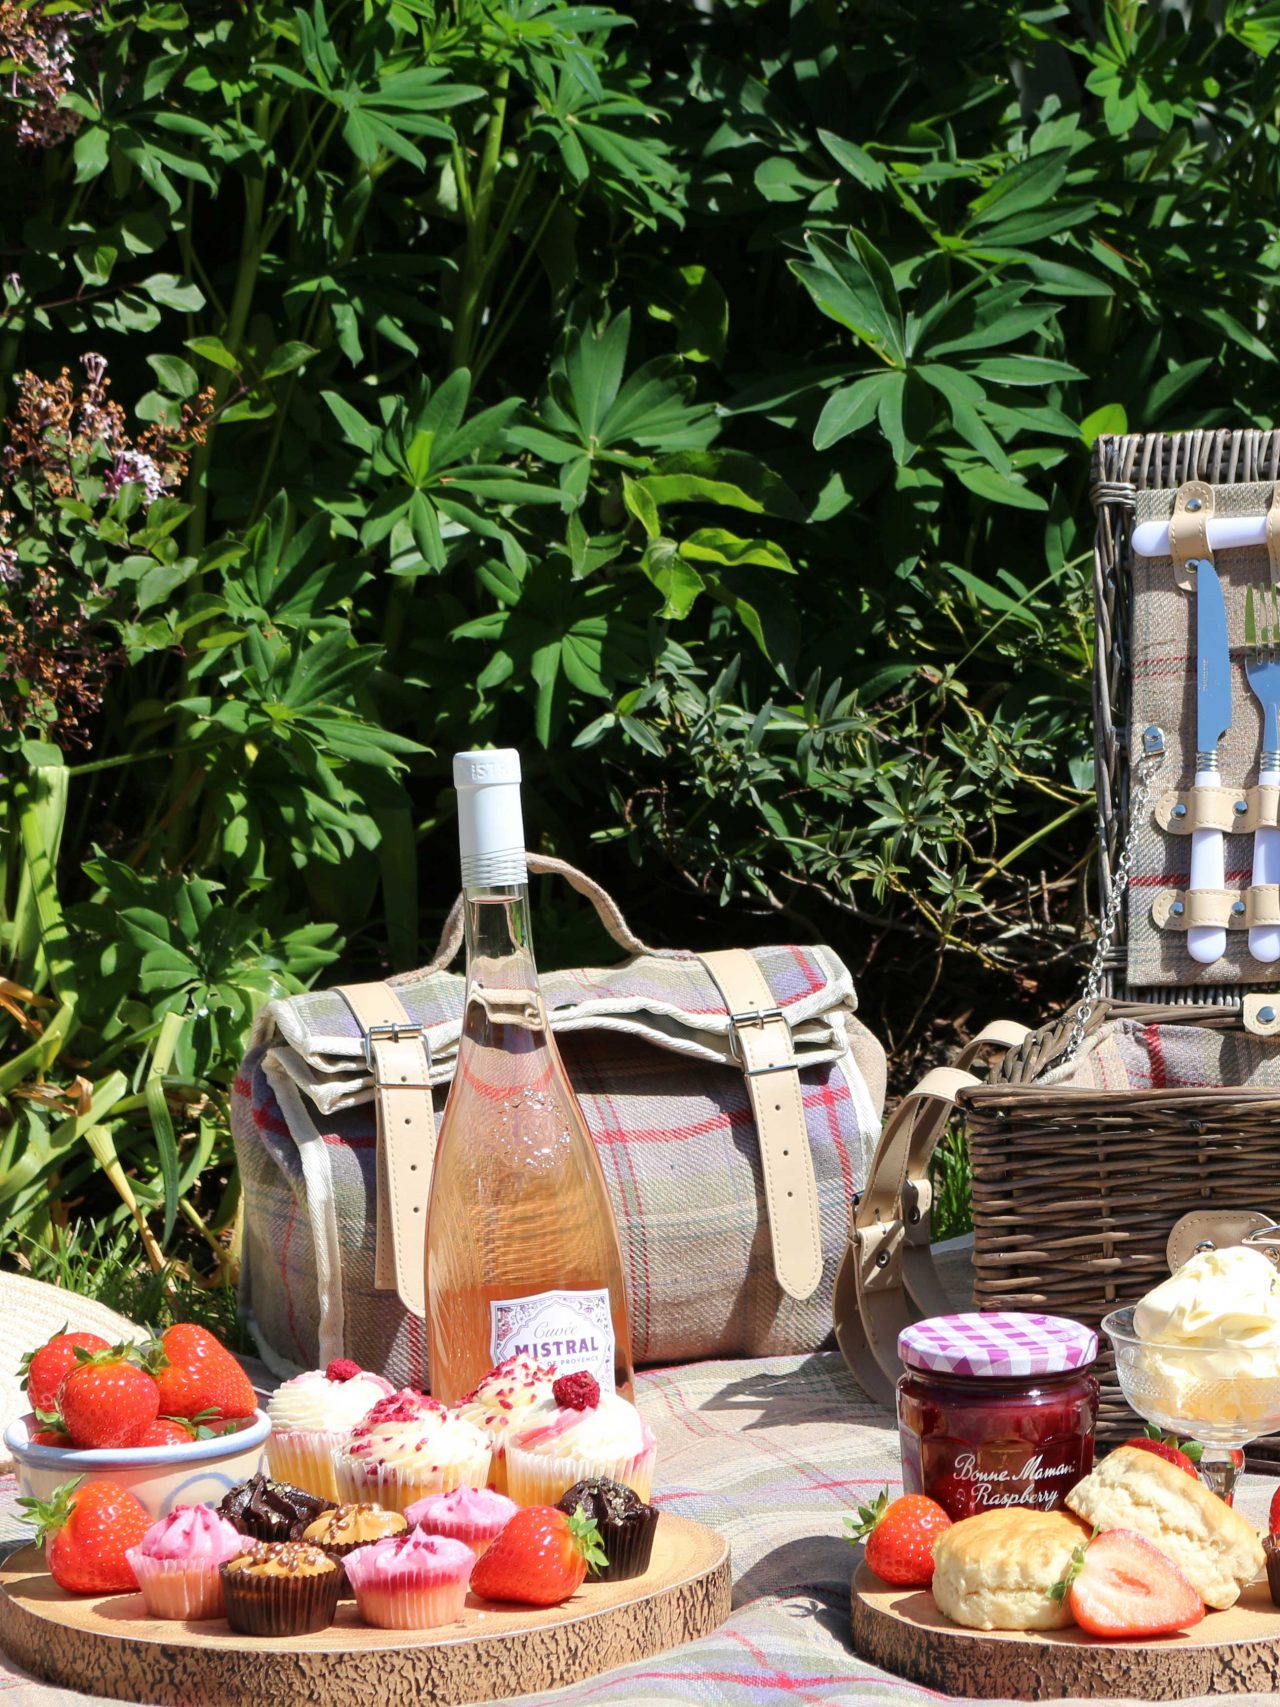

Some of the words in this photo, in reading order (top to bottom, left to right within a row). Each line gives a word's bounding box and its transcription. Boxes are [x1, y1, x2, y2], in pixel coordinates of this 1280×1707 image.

[514, 1336, 599, 1359] MISTRAL
[560, 1356, 599, 1365] PROVENCE
[953, 1453, 1010, 1482] Bonne
[1012, 1454, 1073, 1481] Maman
[971, 1484, 1059, 1512] Raspberry
